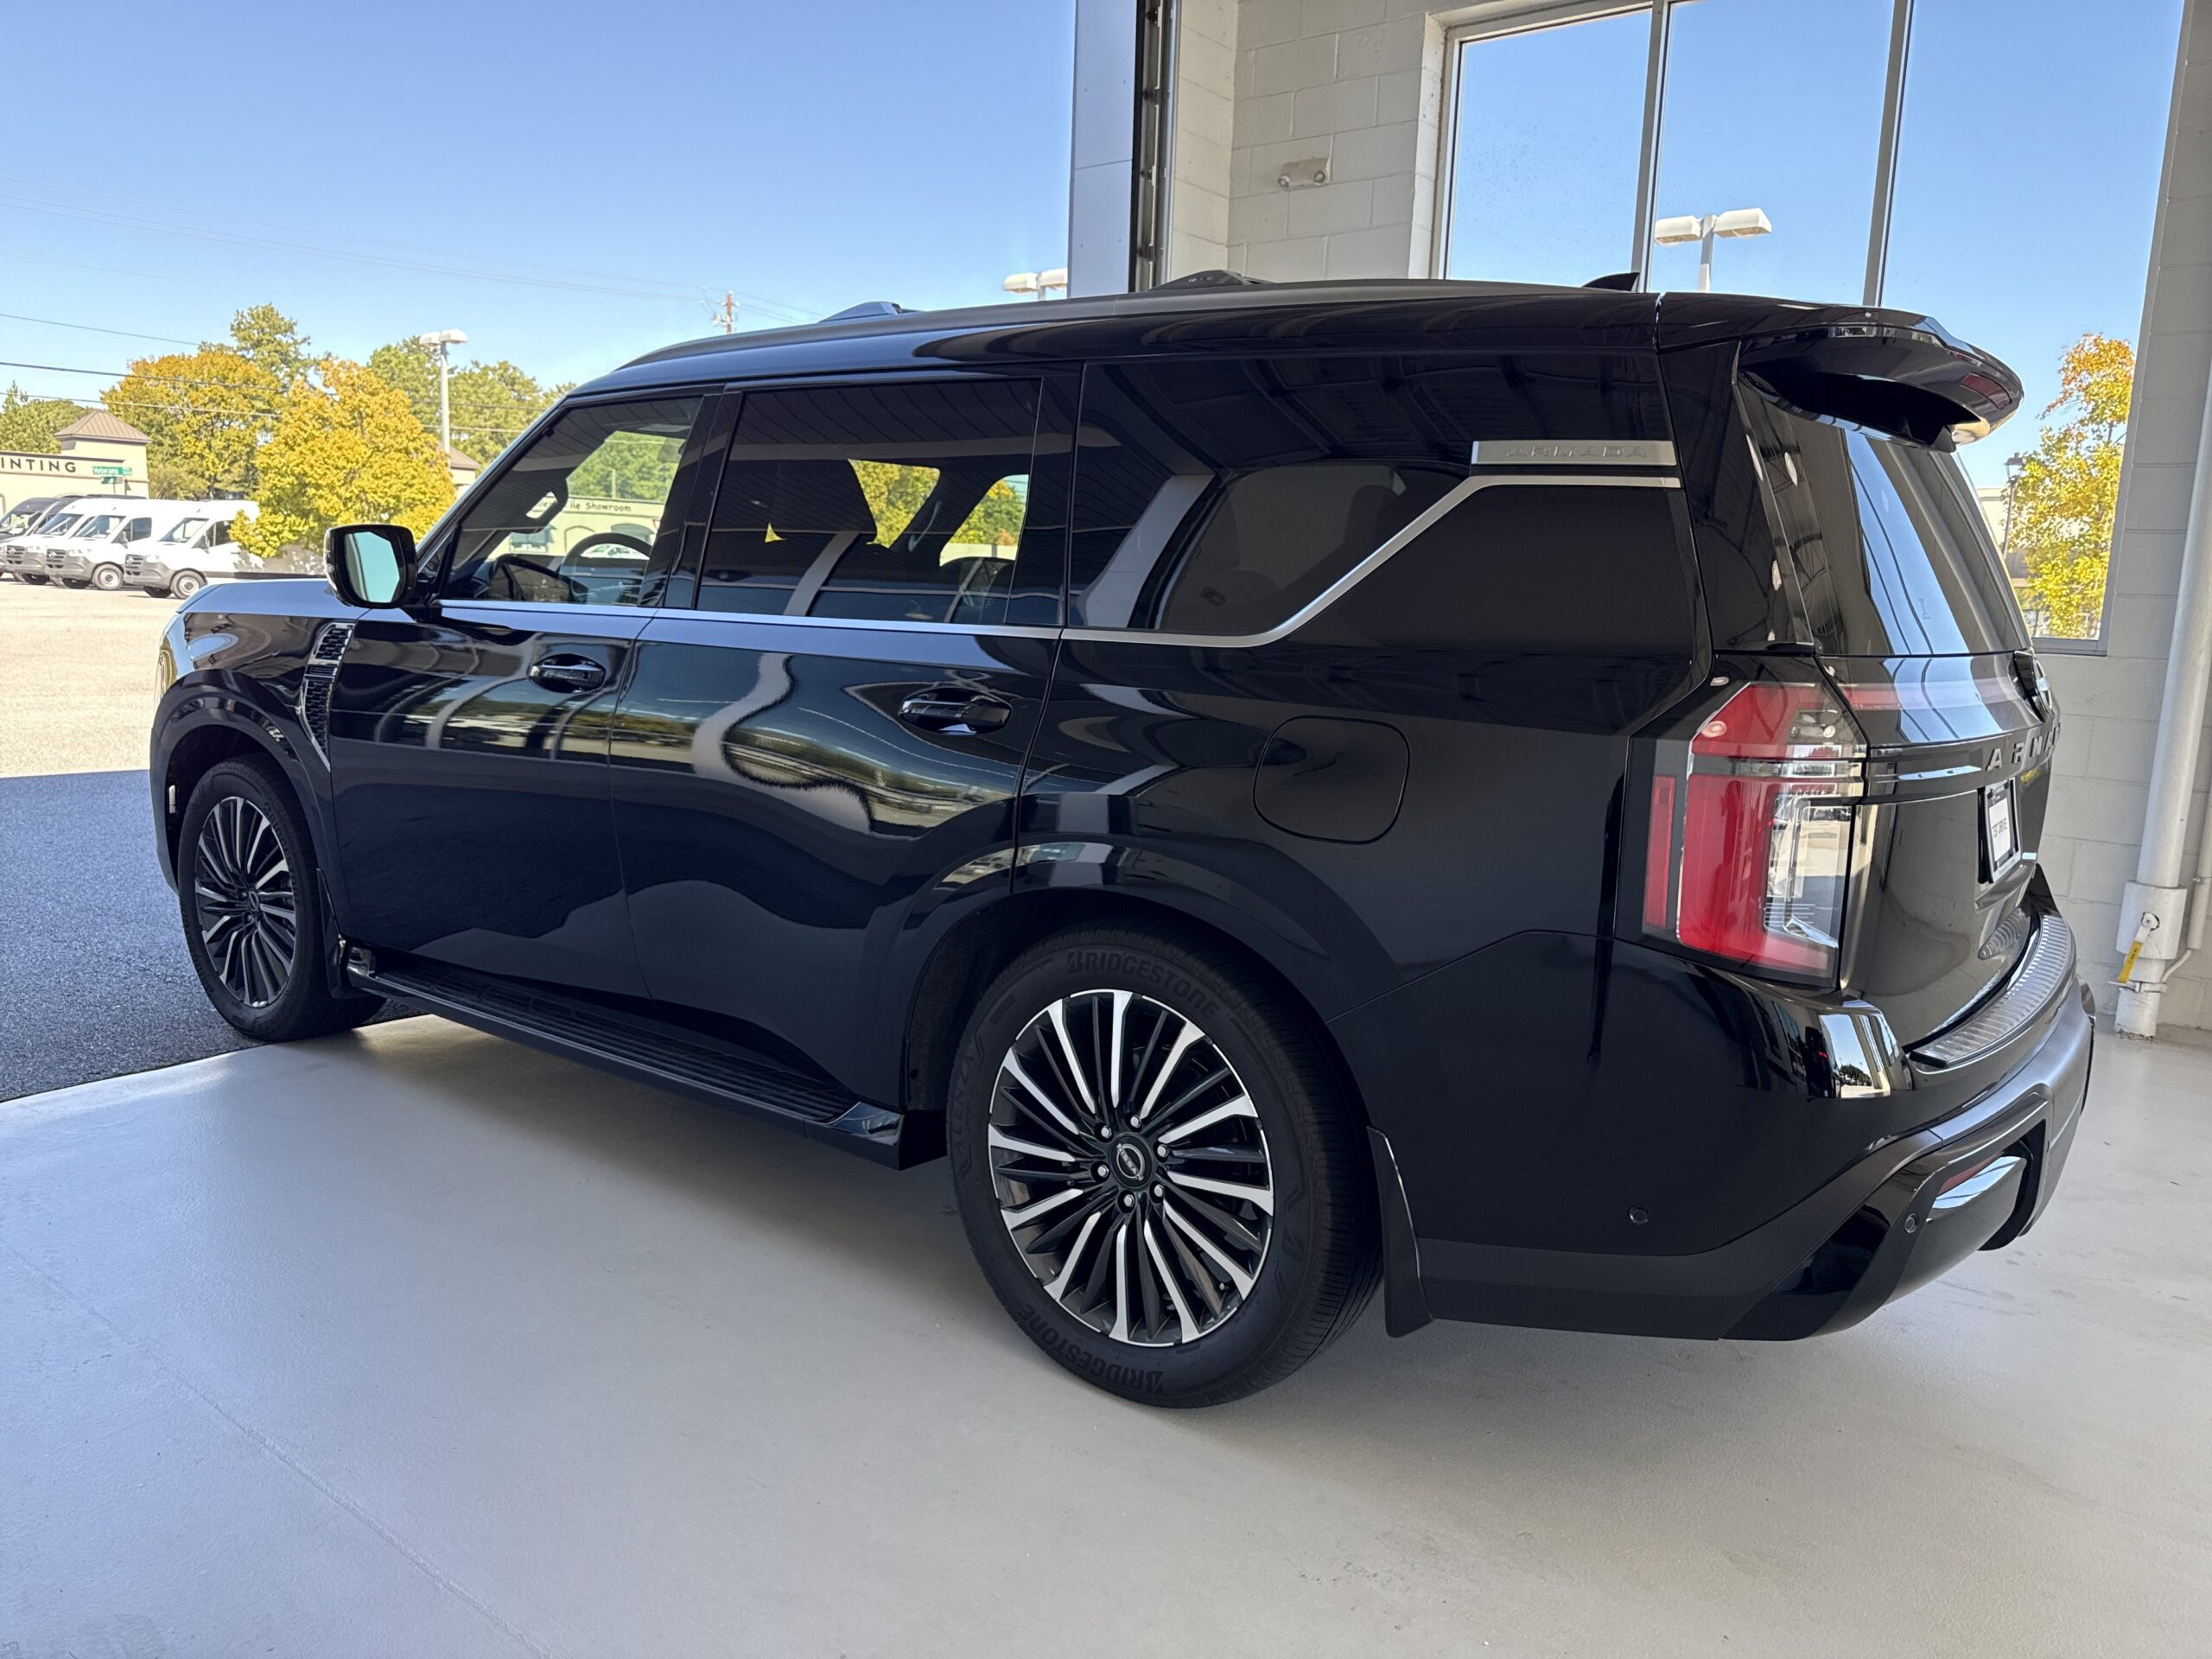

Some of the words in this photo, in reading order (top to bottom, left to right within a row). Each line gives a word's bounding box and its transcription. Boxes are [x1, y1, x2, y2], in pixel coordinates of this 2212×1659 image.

[586, 501, 632, 512] Showroom
[1067, 950, 1220, 1020] BRIDGESTONE
[1116, 1142, 1145, 1181] NISSAN
[1016, 1302, 1165, 1394] BRIDGESTONE
